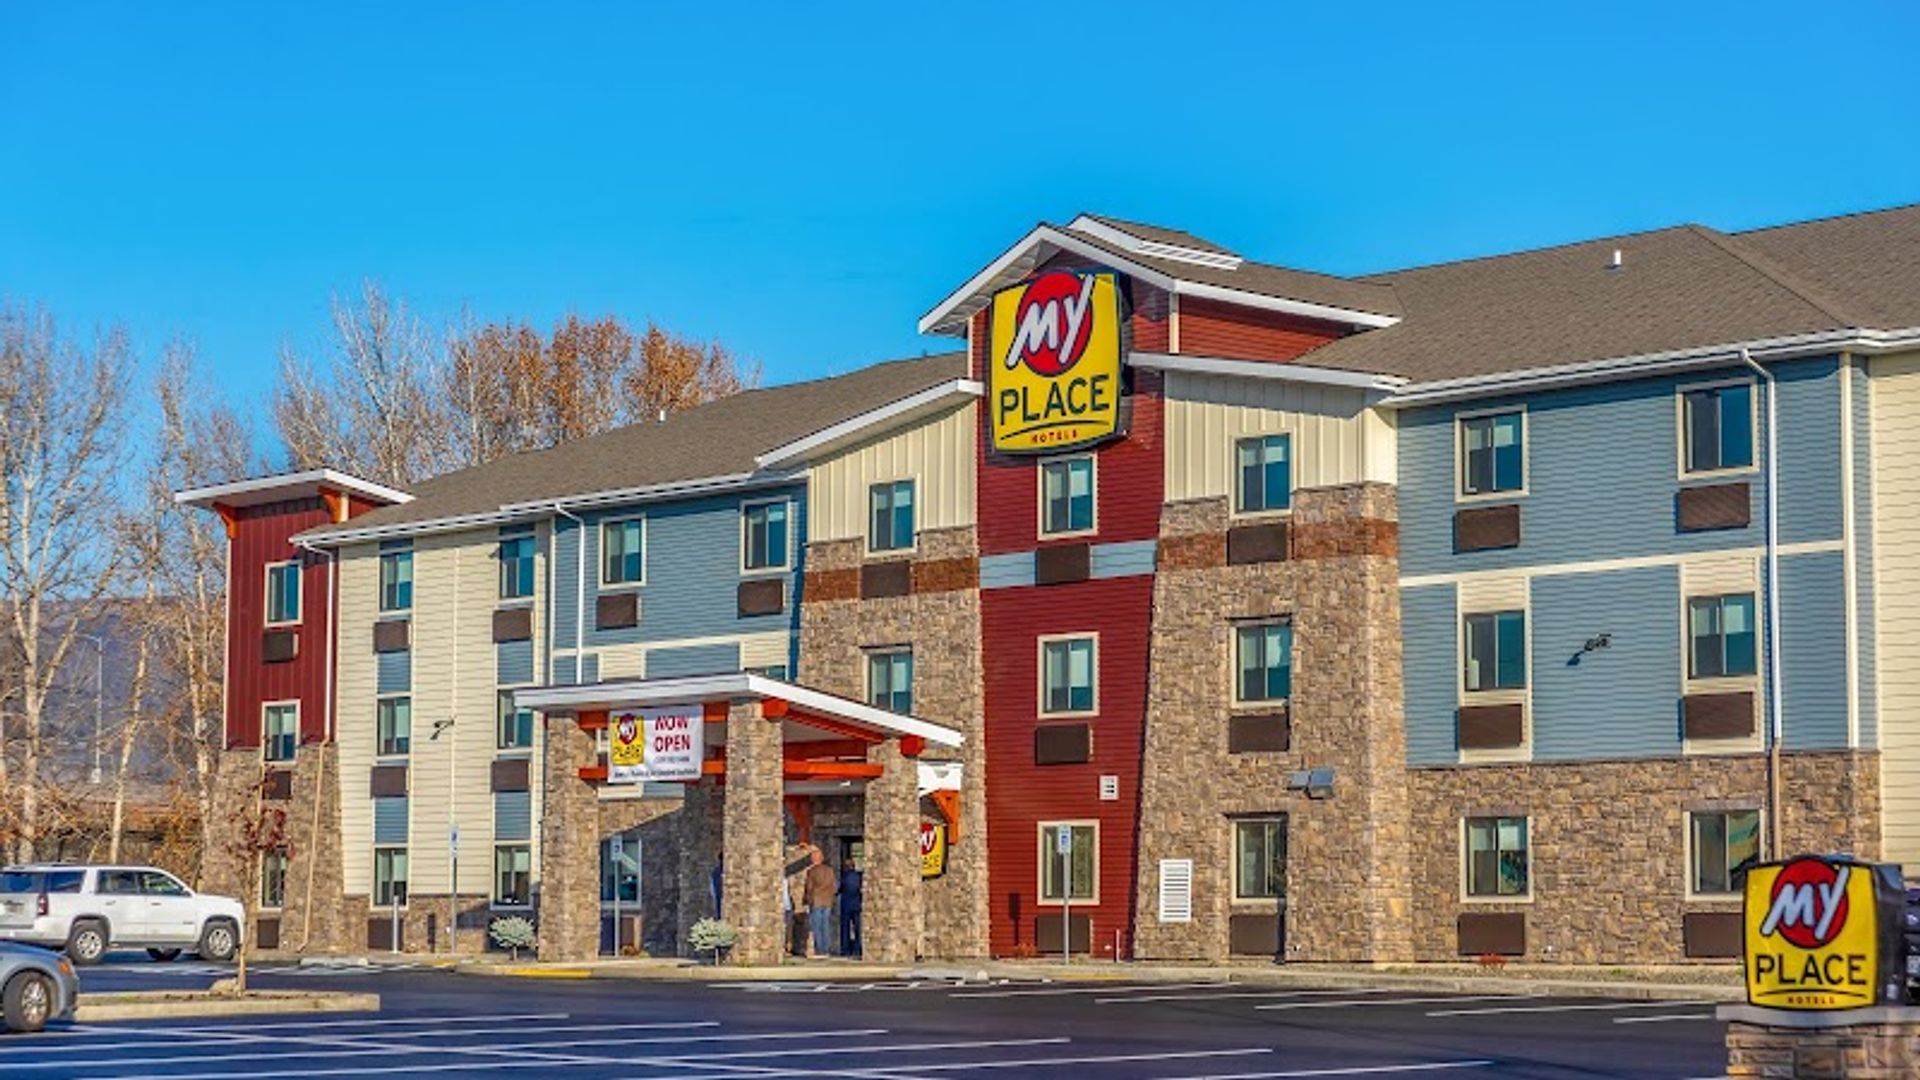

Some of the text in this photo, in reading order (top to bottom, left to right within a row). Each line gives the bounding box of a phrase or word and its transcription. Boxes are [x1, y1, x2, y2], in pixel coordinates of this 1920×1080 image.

[999, 374, 1110, 426] PLACE
[654, 714, 689, 731] NOW
[654, 734, 691, 752] OPEN
[1755, 953, 1867, 986] PLACE
[1787, 995, 1836, 1005] HOTELS
